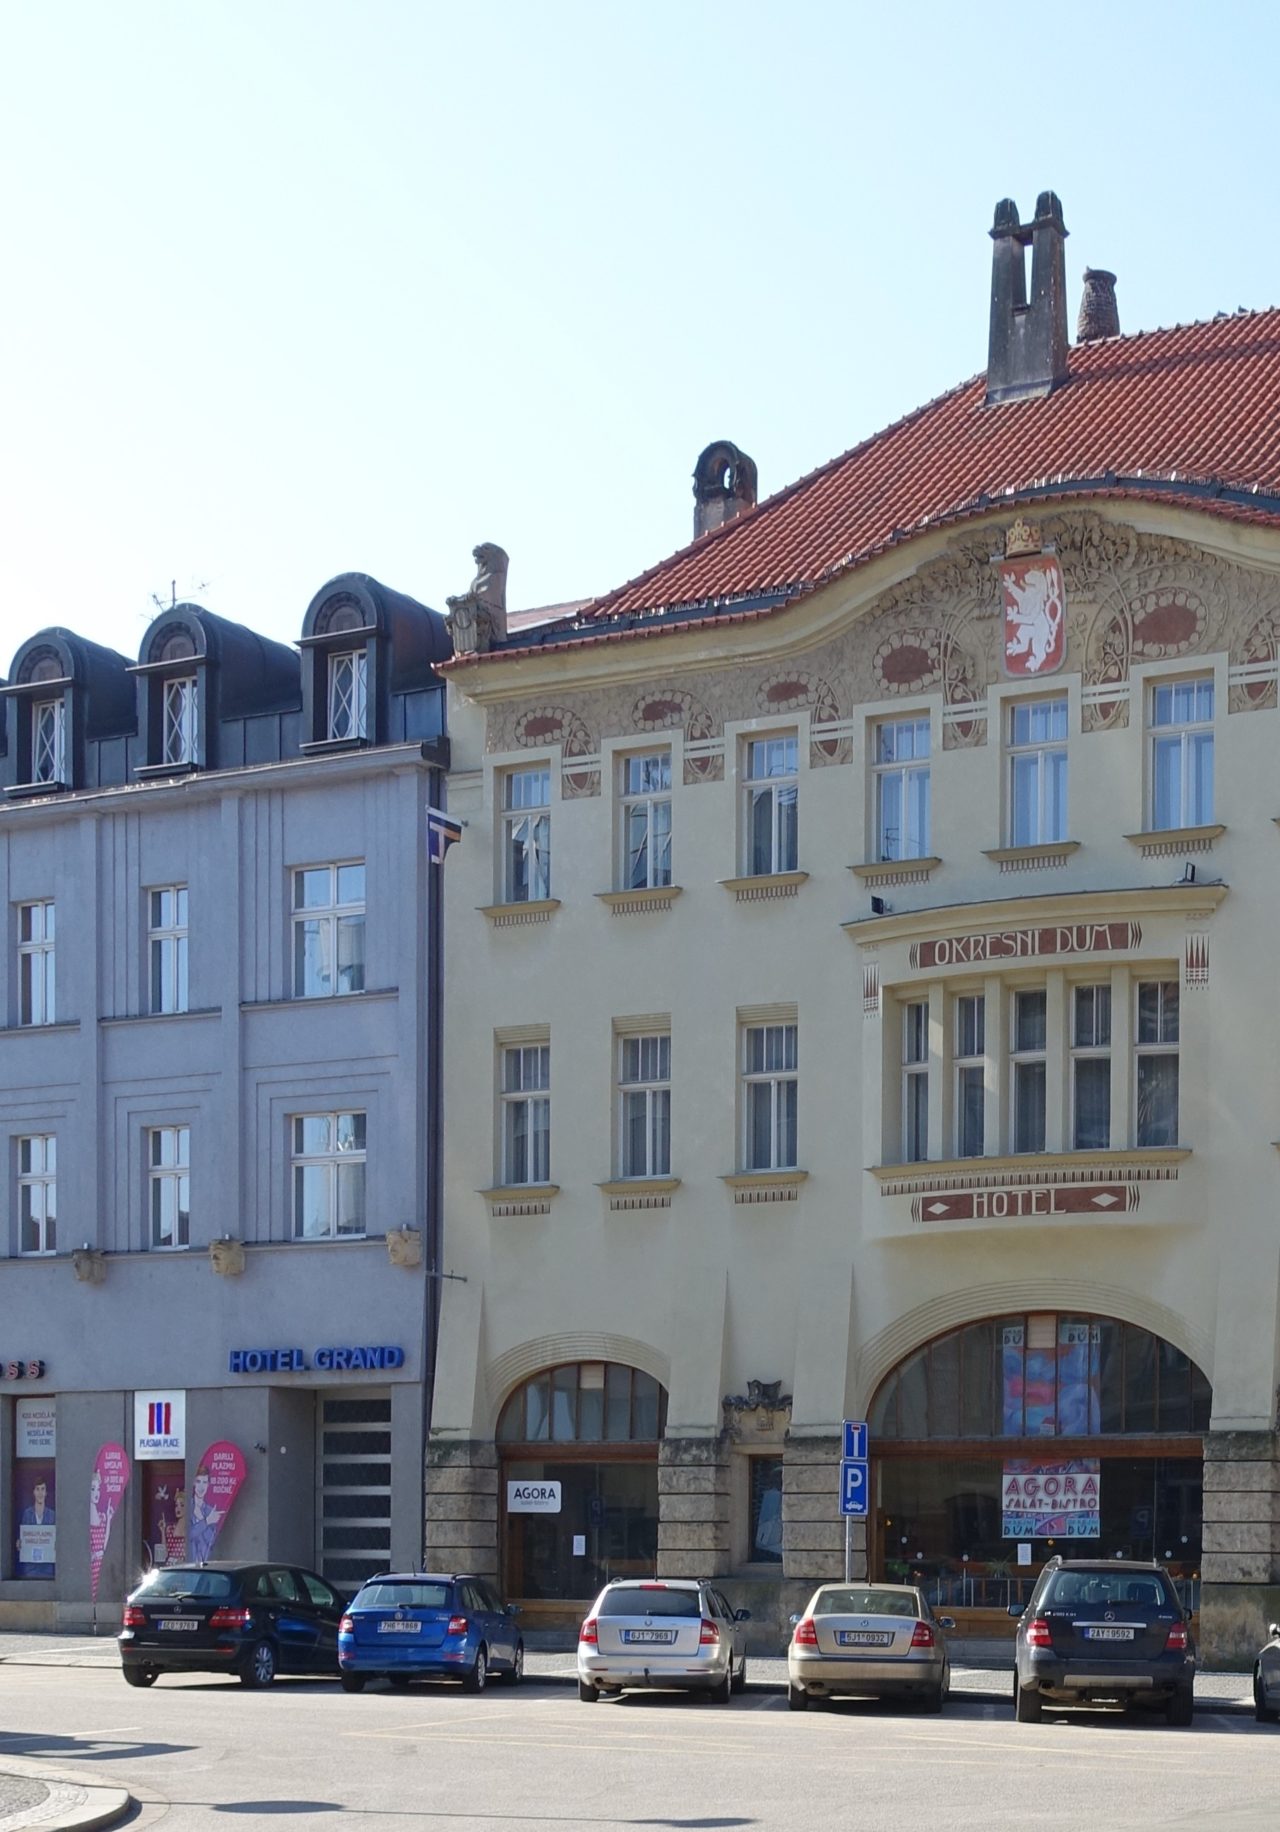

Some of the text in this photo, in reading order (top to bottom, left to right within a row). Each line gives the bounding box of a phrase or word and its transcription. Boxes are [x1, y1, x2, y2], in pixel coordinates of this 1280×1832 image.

[934, 929, 1042, 965] OKRESNÍ
[972, 1189, 1066, 1218] HOTEL
[229, 1346, 405, 1372] HOTEL GRAND
[140, 1438, 179, 1448] PLASMA PLACE
[513, 1487, 556, 1500] AGORA
[847, 1468, 863, 1498] P
[1006, 1476, 1098, 1496] AGORA
